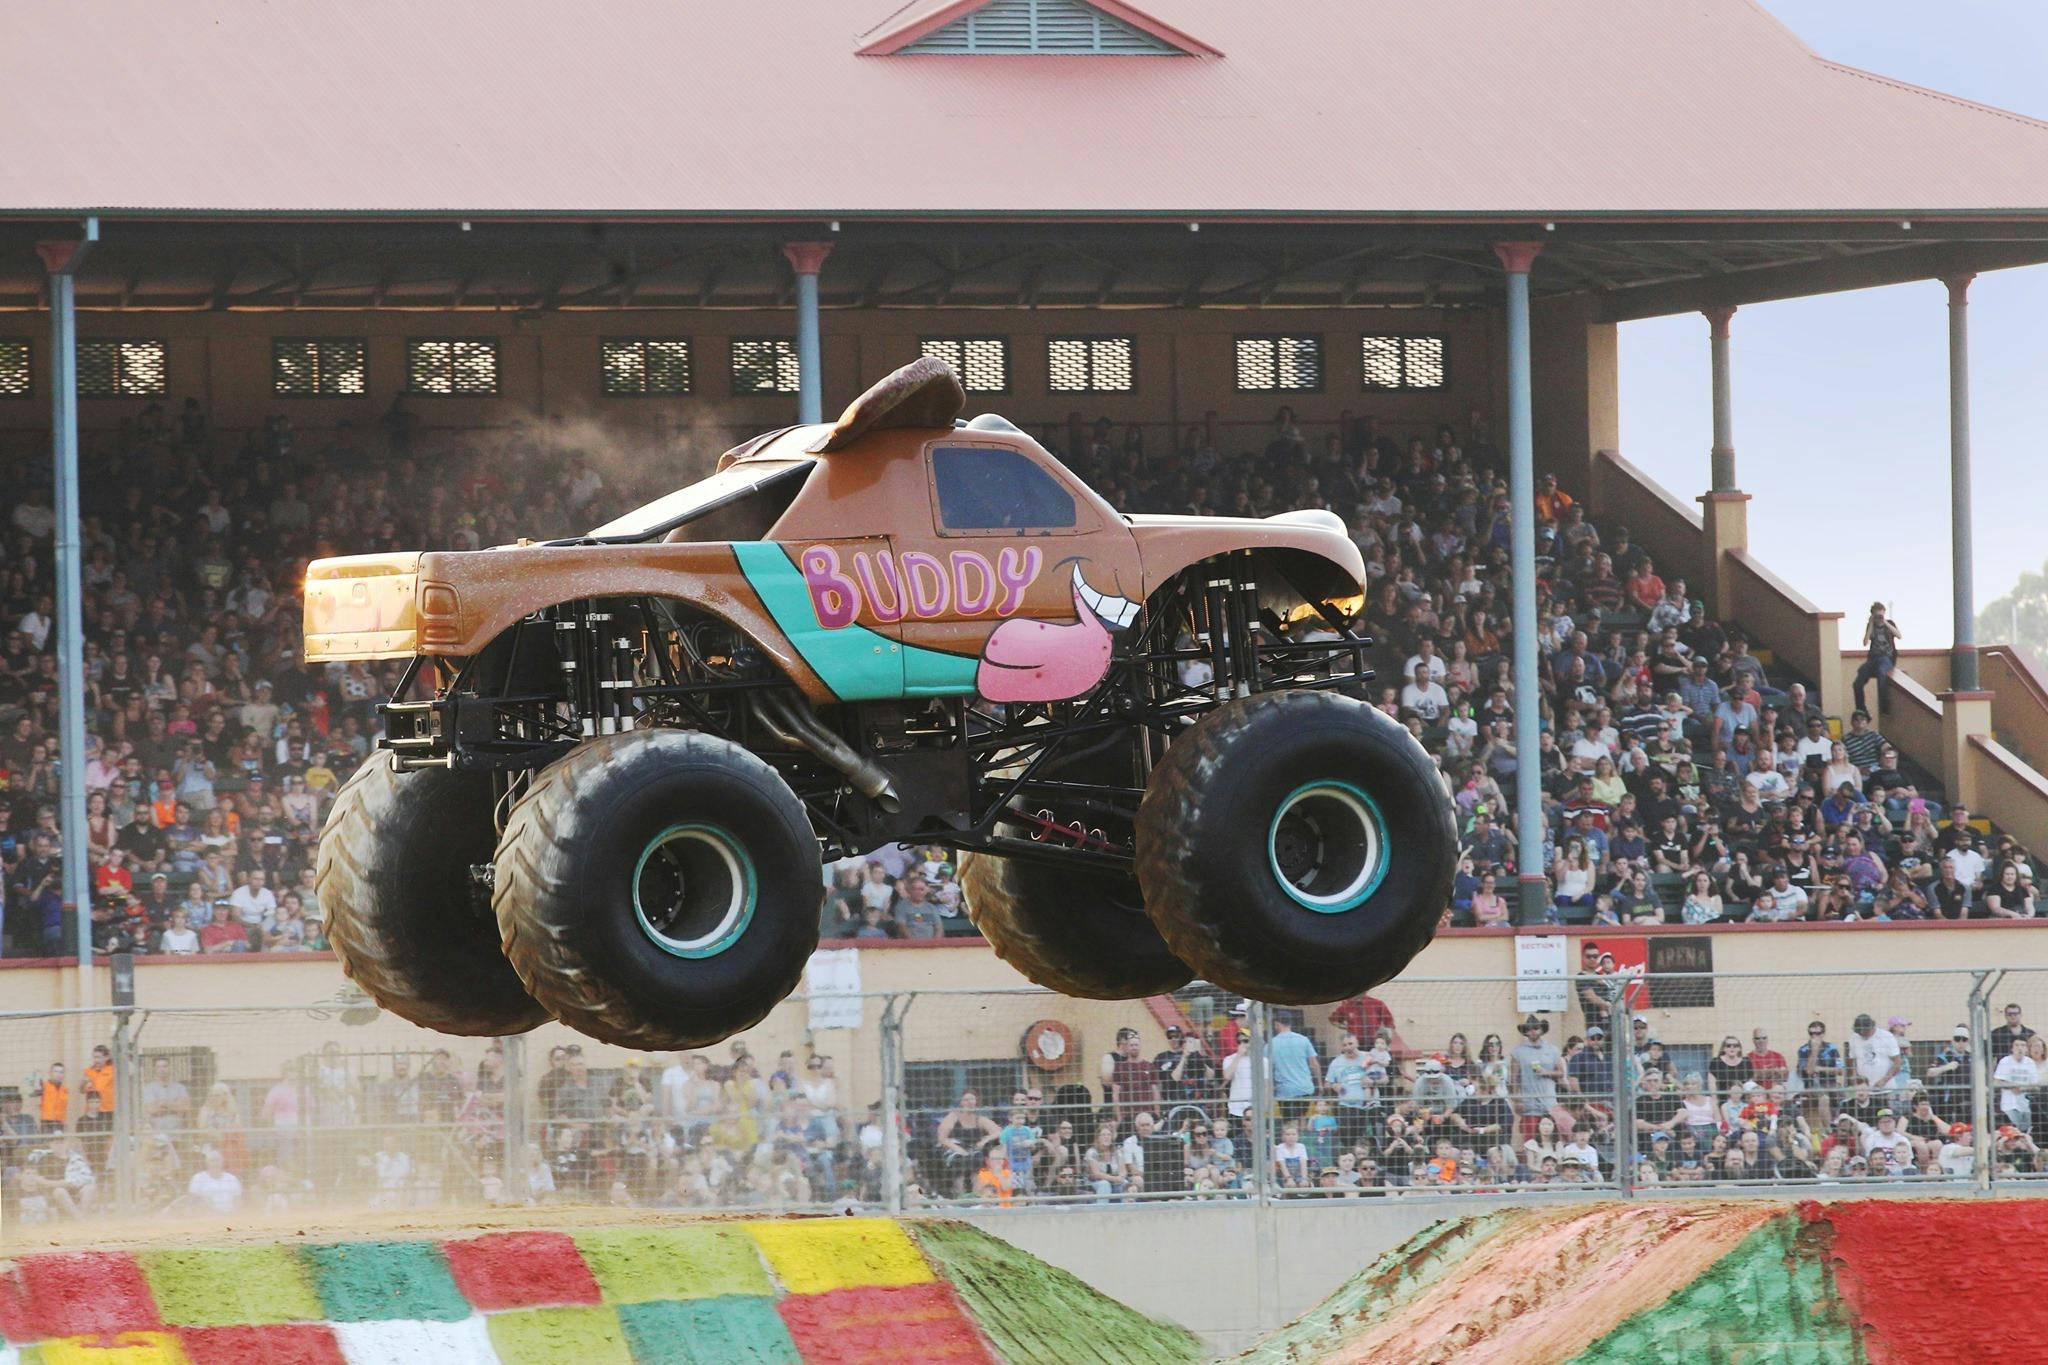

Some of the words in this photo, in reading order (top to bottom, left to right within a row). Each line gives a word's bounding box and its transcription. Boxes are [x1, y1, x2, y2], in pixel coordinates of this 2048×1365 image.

[800, 544, 1043, 630] BUDDY
[1655, 946, 1707, 968] ARENA
[1523, 968, 1541, 976] ROW
